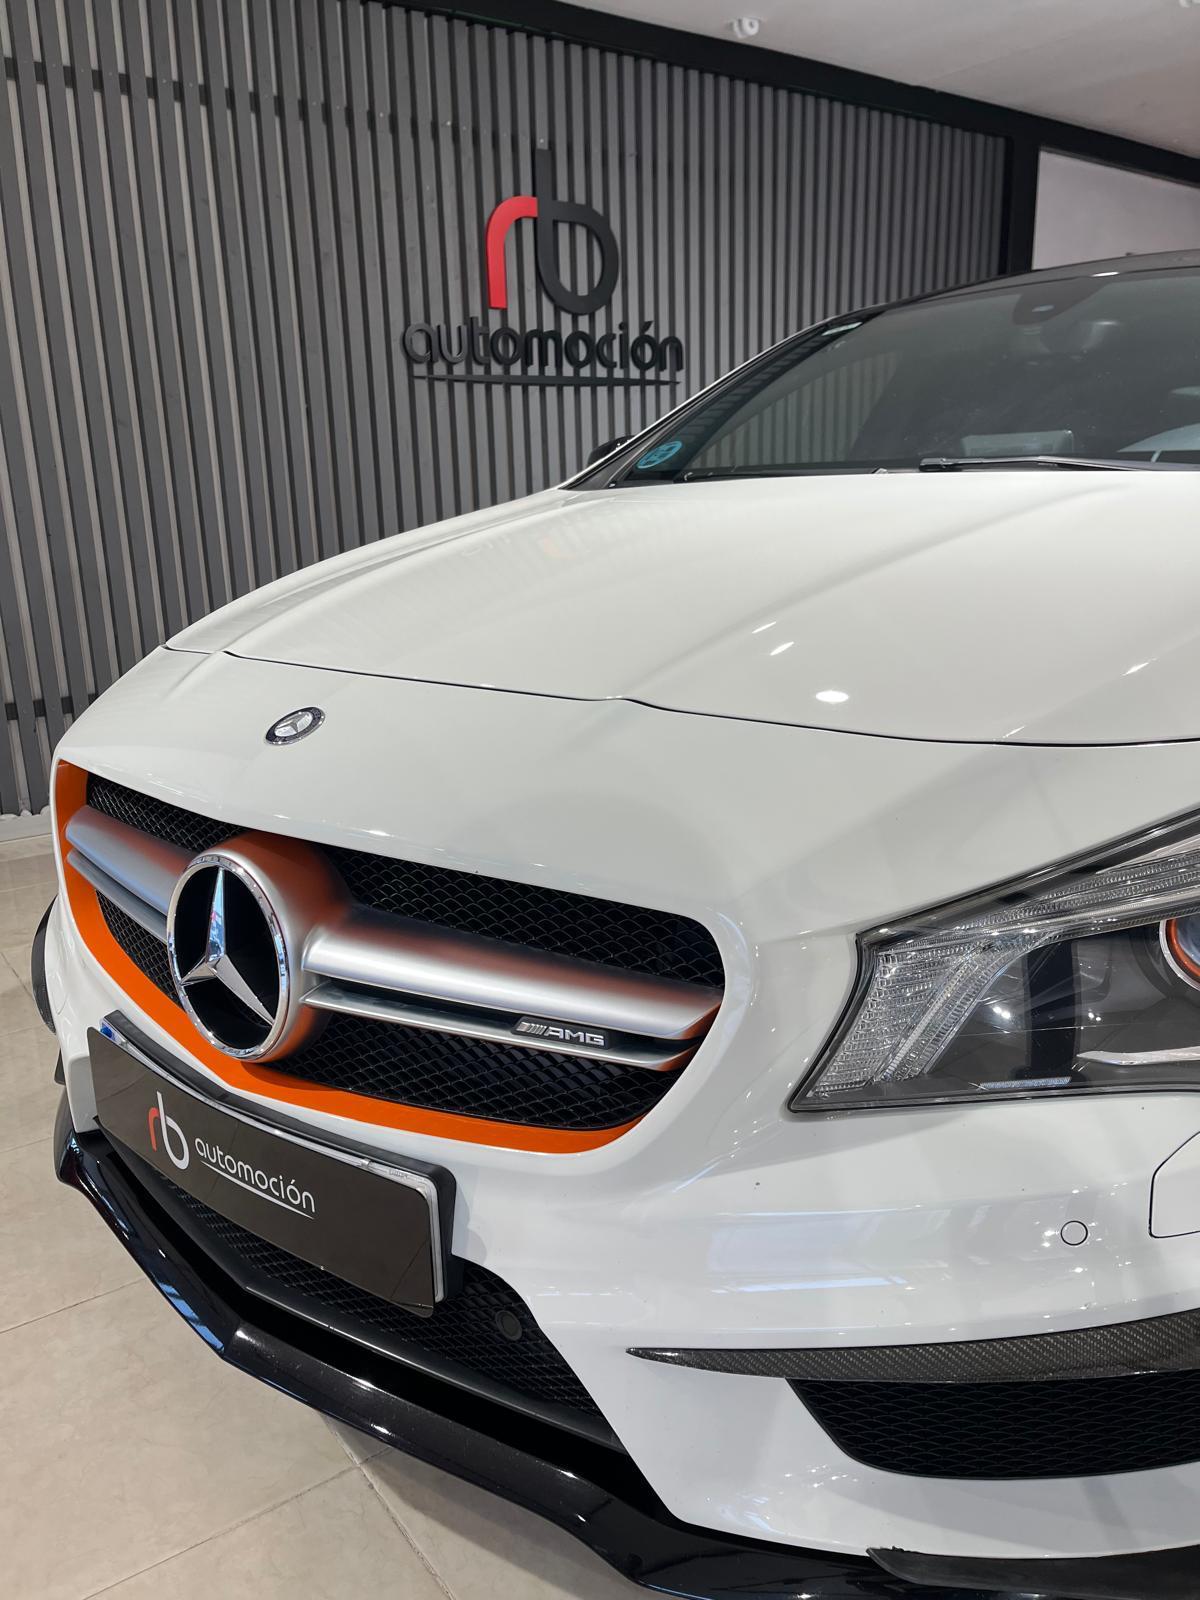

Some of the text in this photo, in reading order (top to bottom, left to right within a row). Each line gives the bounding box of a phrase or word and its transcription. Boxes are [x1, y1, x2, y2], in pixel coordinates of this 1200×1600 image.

[486, 148, 619, 316] rb
[402, 316, 683, 371] automoción
[543, 1026, 605, 1046] AMG
[147, 1091, 316, 1213] rb automoción
